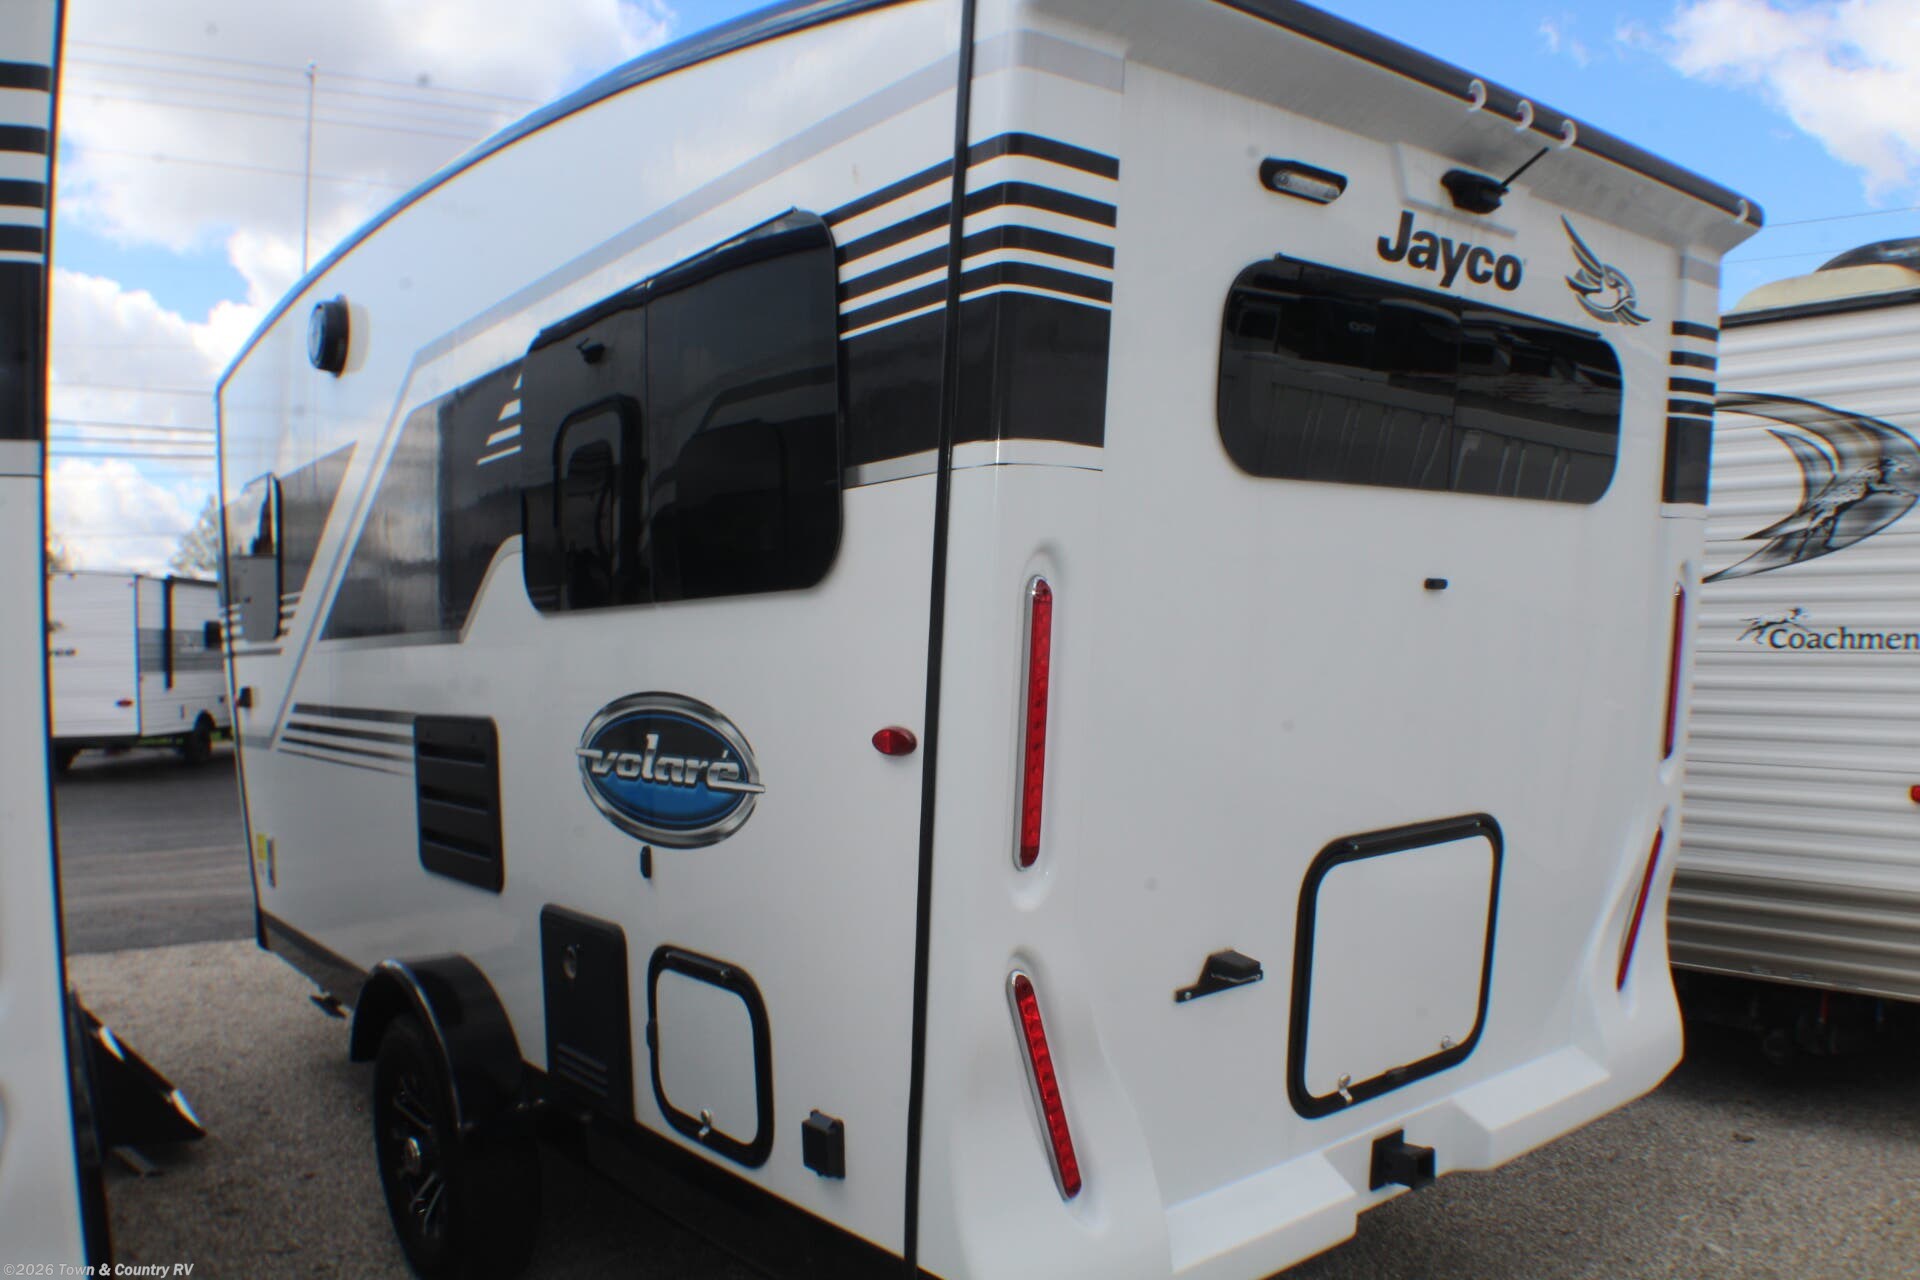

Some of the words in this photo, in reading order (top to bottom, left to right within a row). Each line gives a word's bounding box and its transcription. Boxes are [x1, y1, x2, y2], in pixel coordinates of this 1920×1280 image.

[1377, 210, 1522, 292] Jayco
[1768, 626, 1920, 650] Coachmen
[576, 733, 766, 793] volaré
